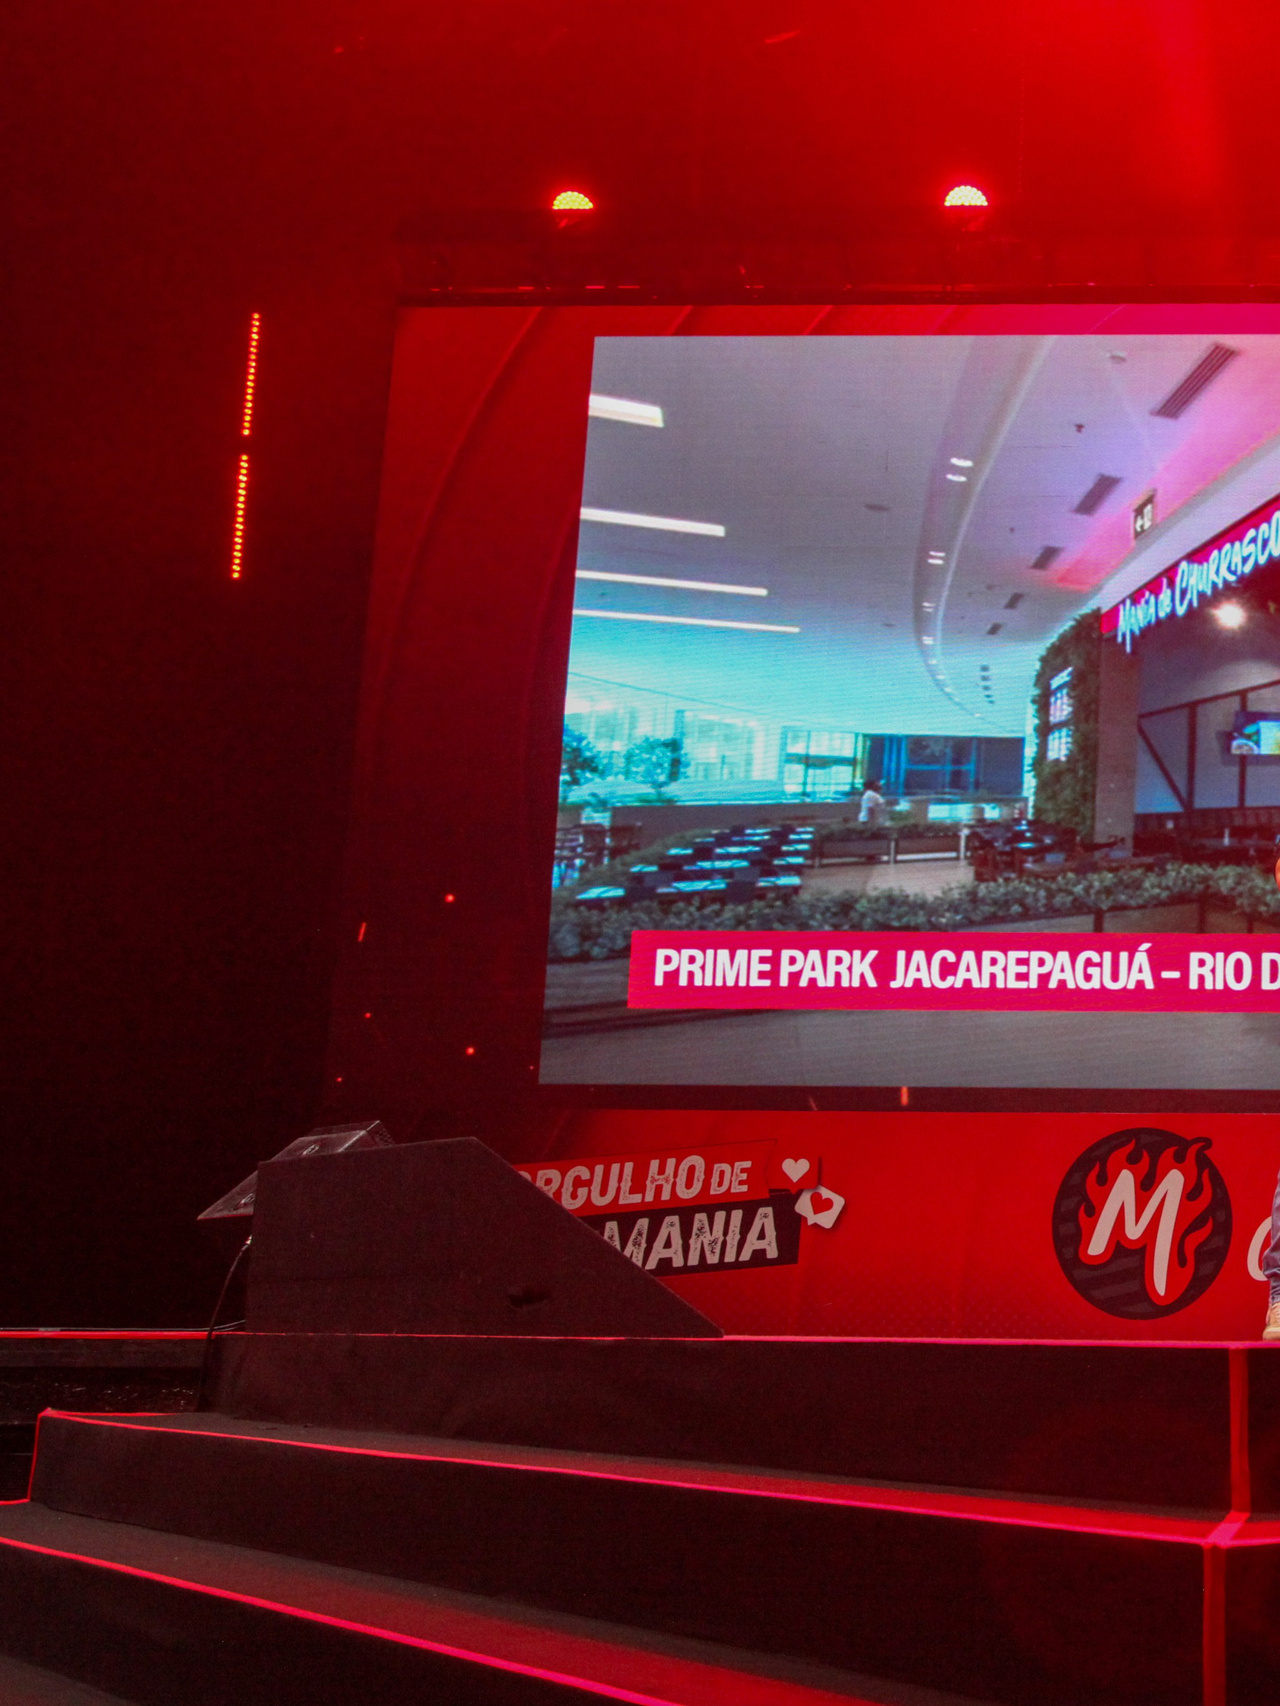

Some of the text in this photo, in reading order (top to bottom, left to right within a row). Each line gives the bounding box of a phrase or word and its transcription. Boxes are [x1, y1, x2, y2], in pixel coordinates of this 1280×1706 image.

[654, 948, 772, 987] PRIME
[779, 949, 878, 988] PARK
[889, 942, 1154, 991] JACAREPAGUÁ
[1189, 951, 1252, 991] RIO
[710, 1160, 752, 1195] DE
[1088, 1168, 1185, 1296] M
